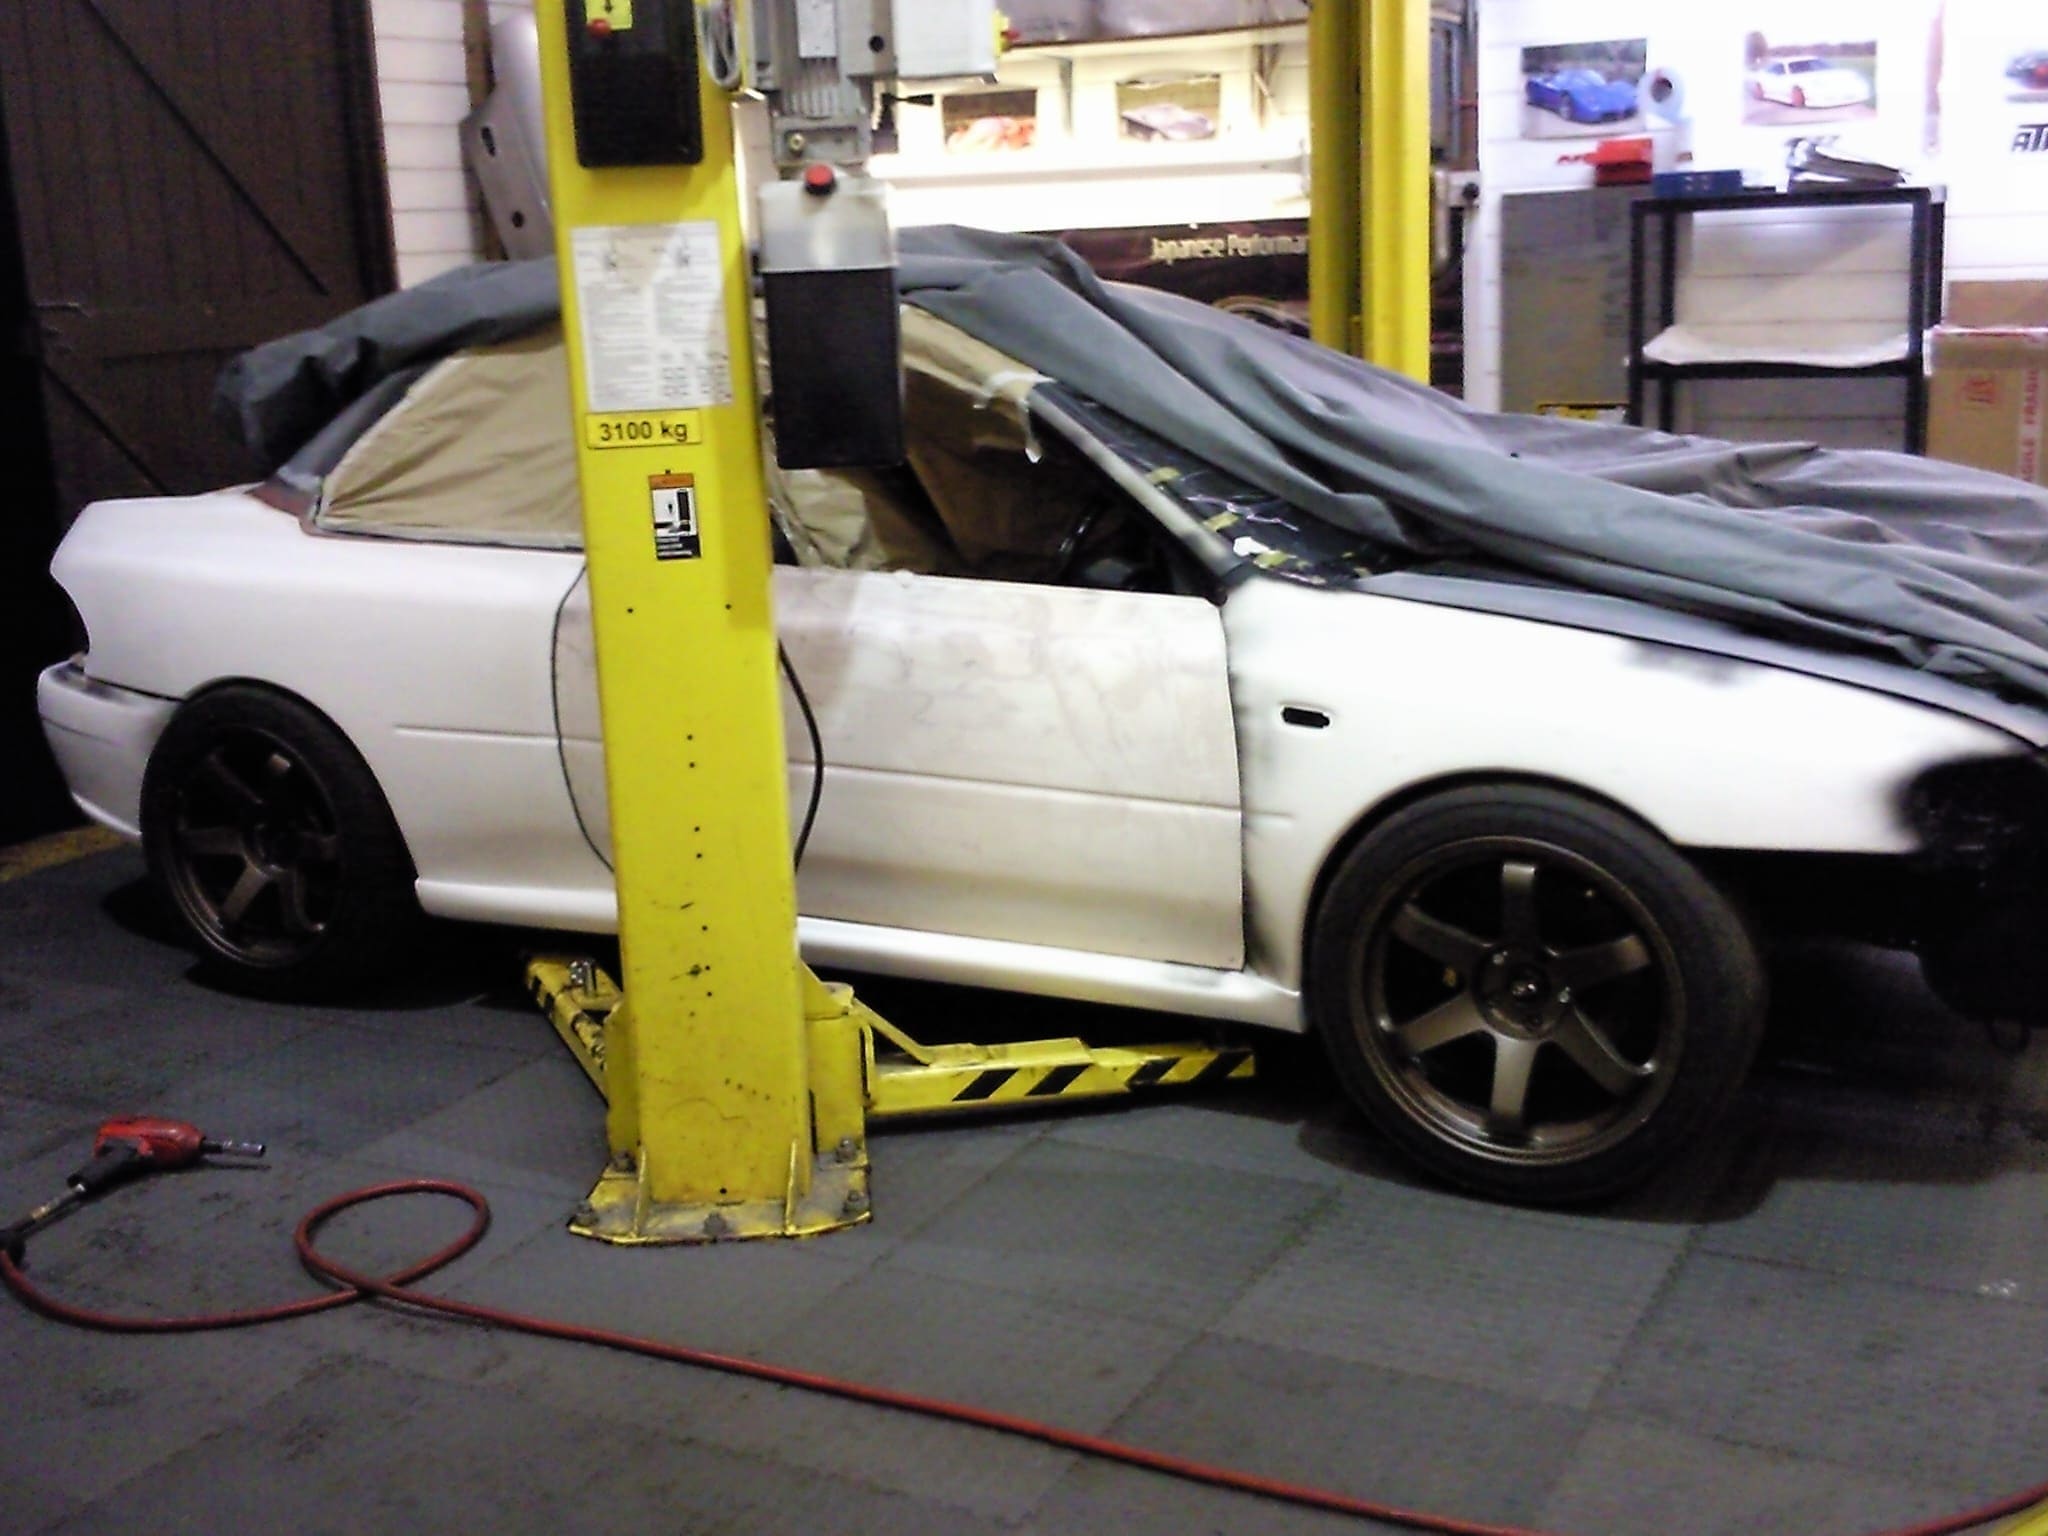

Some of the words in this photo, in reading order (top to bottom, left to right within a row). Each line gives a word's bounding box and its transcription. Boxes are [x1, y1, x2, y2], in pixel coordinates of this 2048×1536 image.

[1150, 238, 1225, 266] Japanese
[599, 420, 653, 442] 3100
[660, 420, 688, 443] kg
